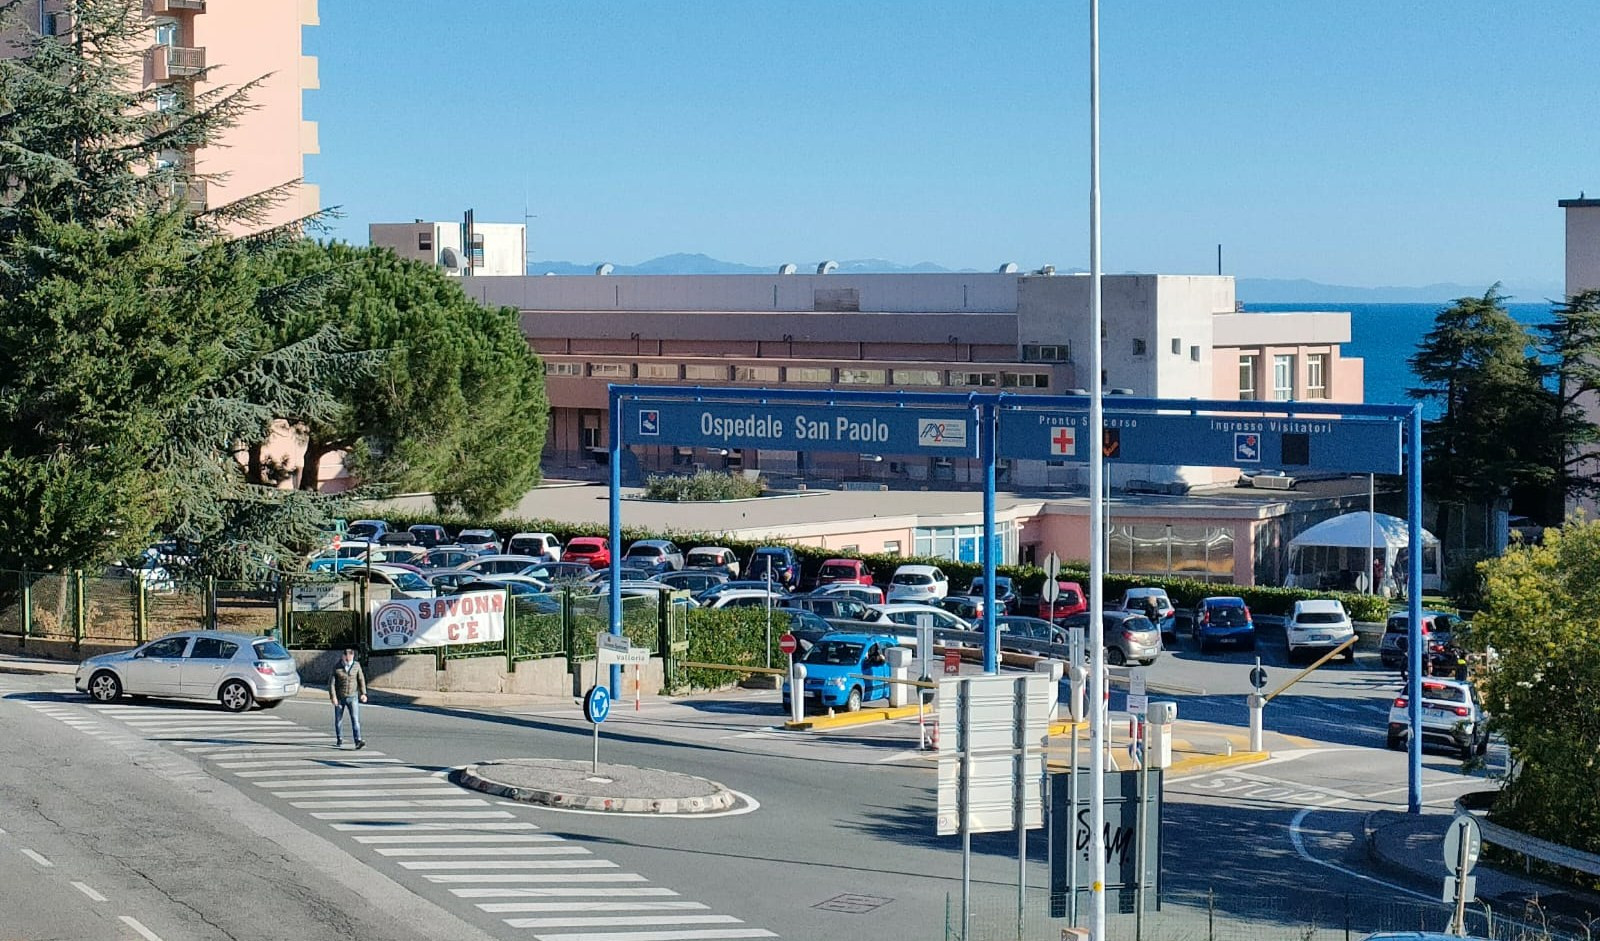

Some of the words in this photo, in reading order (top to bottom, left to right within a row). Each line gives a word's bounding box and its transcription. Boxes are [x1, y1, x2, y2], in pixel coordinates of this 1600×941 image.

[701, 412, 783, 441] Ospedale
[795, 415, 829, 440] San
[836, 416, 889, 442] Paolo
[1039, 415, 1076, 425] Pronto
[1082, 416, 1137, 427] Scorso
[1210, 420, 1263, 432] Ingresso
[1270, 421, 1332, 433] Visitatori
[418, 593, 503, 619] SAVONA
[381, 618, 410, 628] RUGBY
[377, 626, 414, 638] SAVONA
[1190, 777, 1327, 801] STOP
